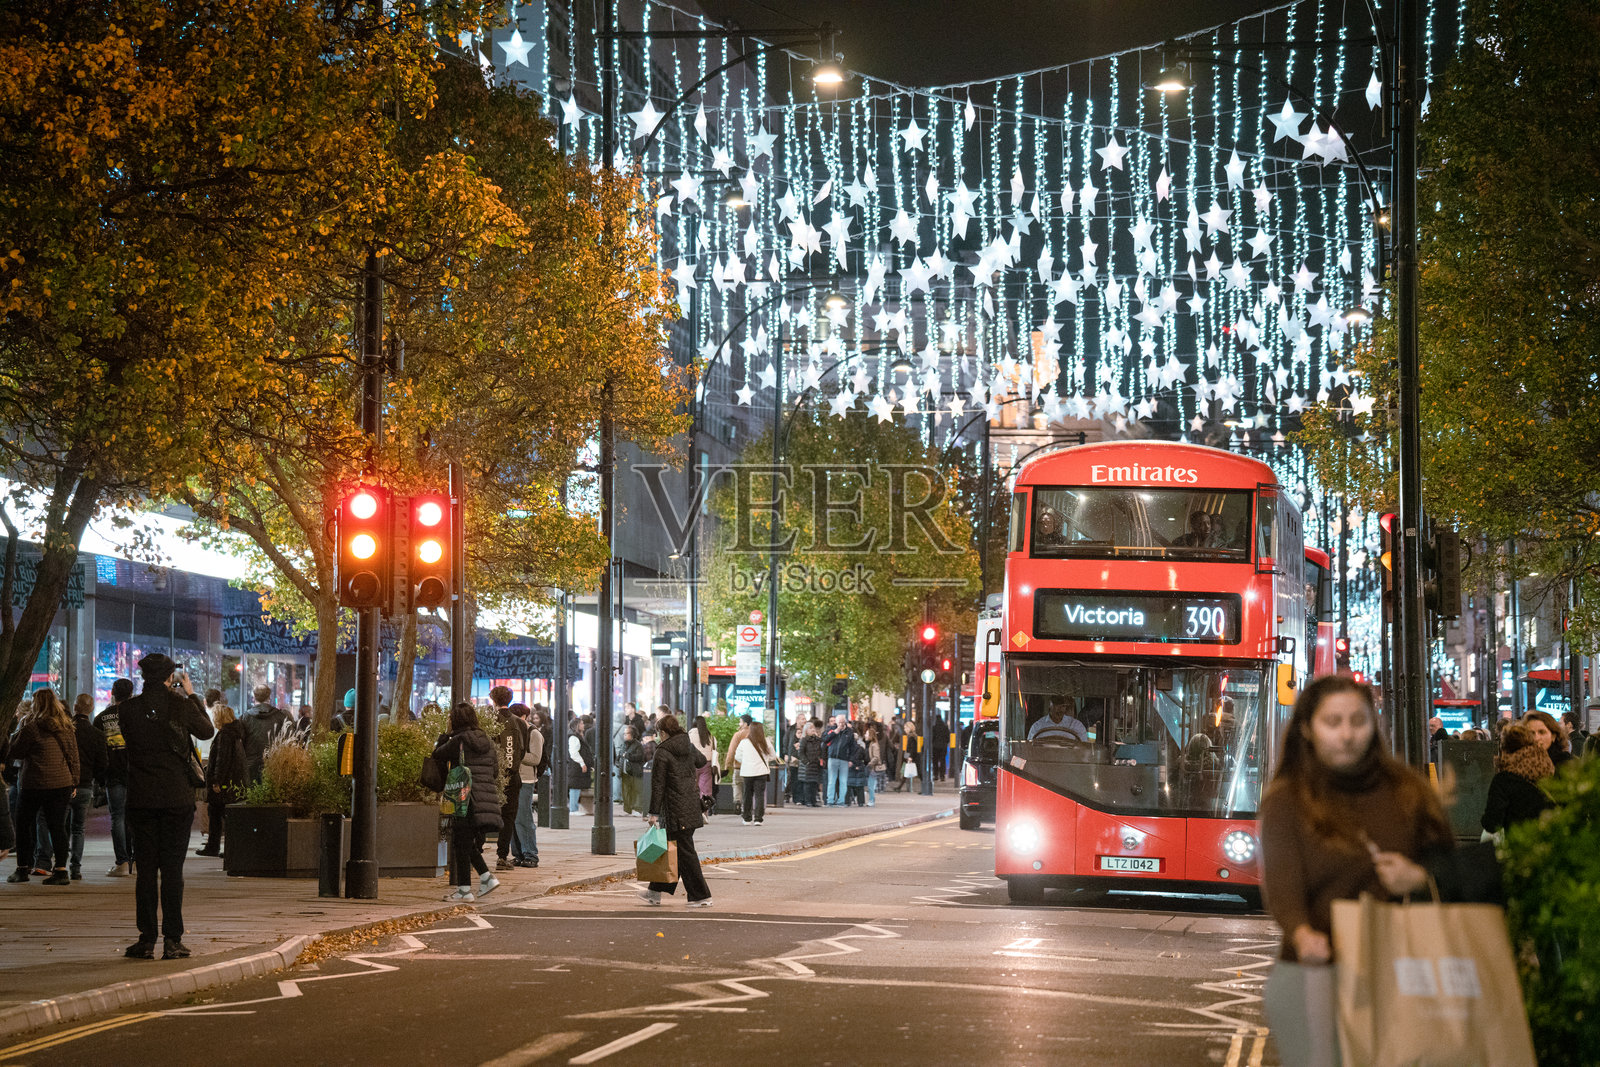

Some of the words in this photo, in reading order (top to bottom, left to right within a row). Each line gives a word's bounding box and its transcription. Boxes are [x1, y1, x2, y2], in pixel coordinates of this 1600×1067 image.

[1091, 462, 1199, 484] Emirates
[223, 616, 253, 629] BLACK
[1064, 603, 1146, 627] Victoria
[1185, 605, 1226, 637] 390
[223, 629, 241, 644] DAY
[242, 628, 270, 642] BLACK
[498, 654, 533, 668] BLACK
[1543, 702, 1570, 711] TIFFA
[505, 735, 513, 769] adidas
[1107, 858, 1128, 869] LTZ
[1130, 859, 1153, 870] 1042
